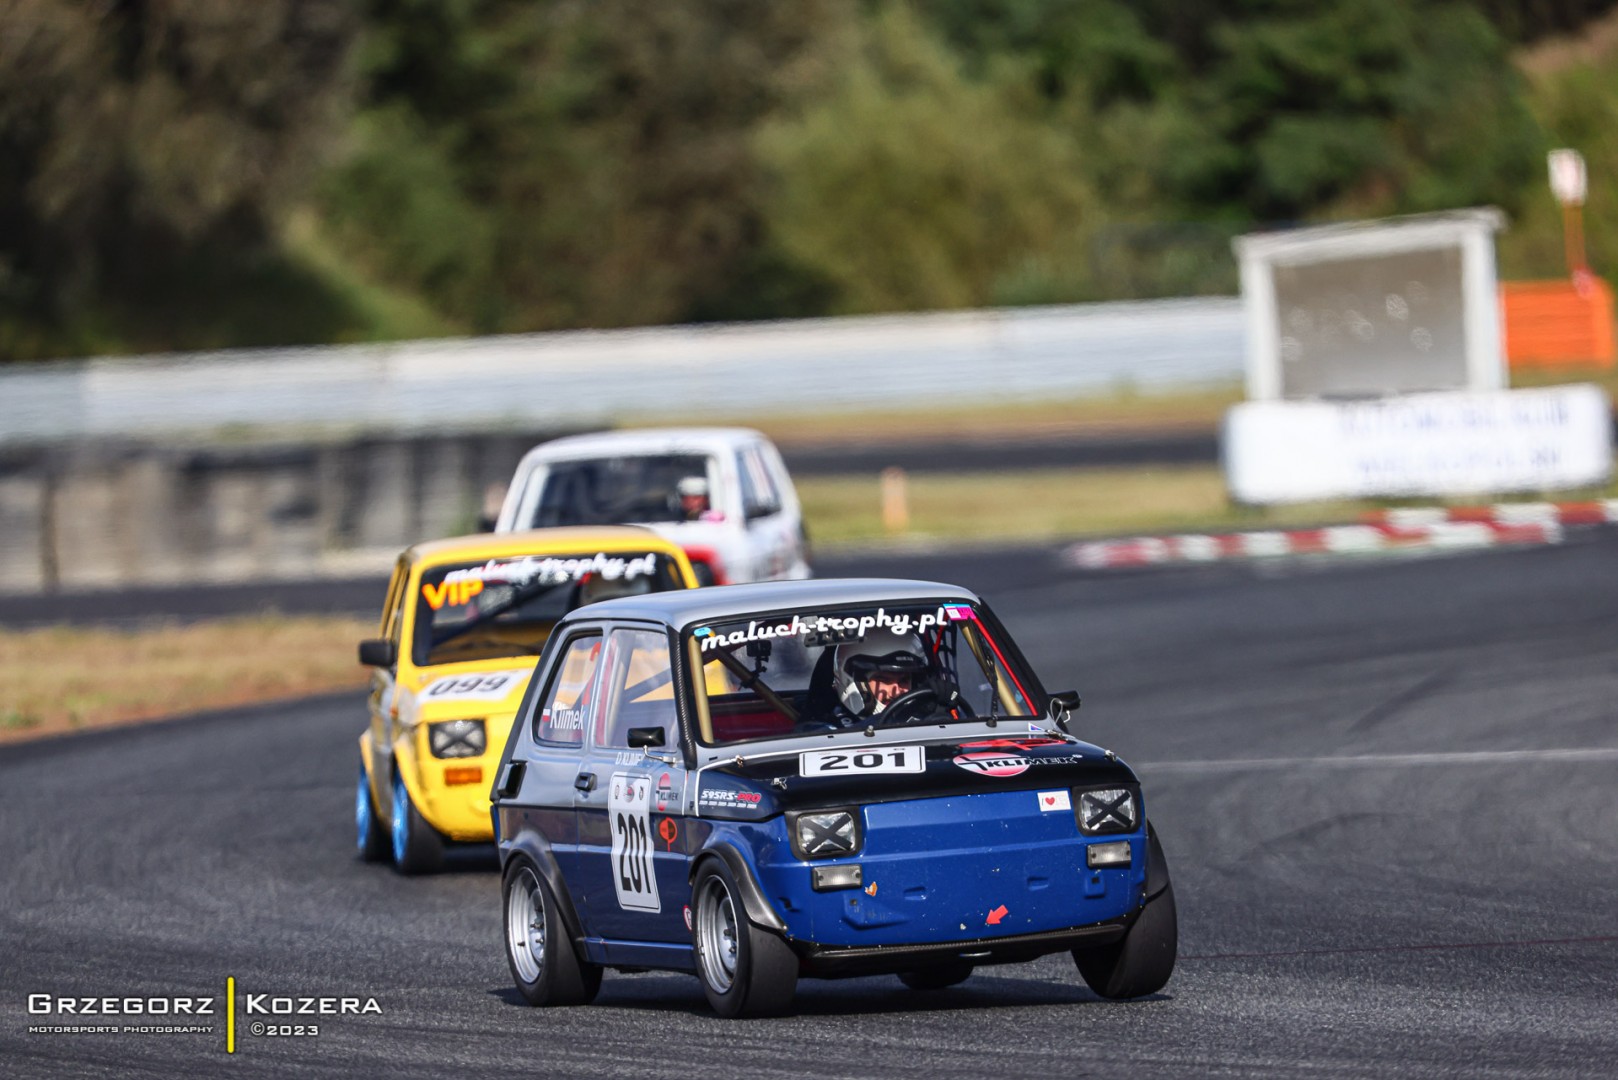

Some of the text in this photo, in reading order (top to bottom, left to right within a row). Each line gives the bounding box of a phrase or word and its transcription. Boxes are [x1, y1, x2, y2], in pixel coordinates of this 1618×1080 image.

[422, 578, 484, 610] VIP
[701, 608, 948, 652] maluch-trophy.pl
[429, 676, 509, 696] 099
[550, 706, 586, 730] Klimek
[819, 751, 906, 771] 201
[617, 812, 652, 894] 201
